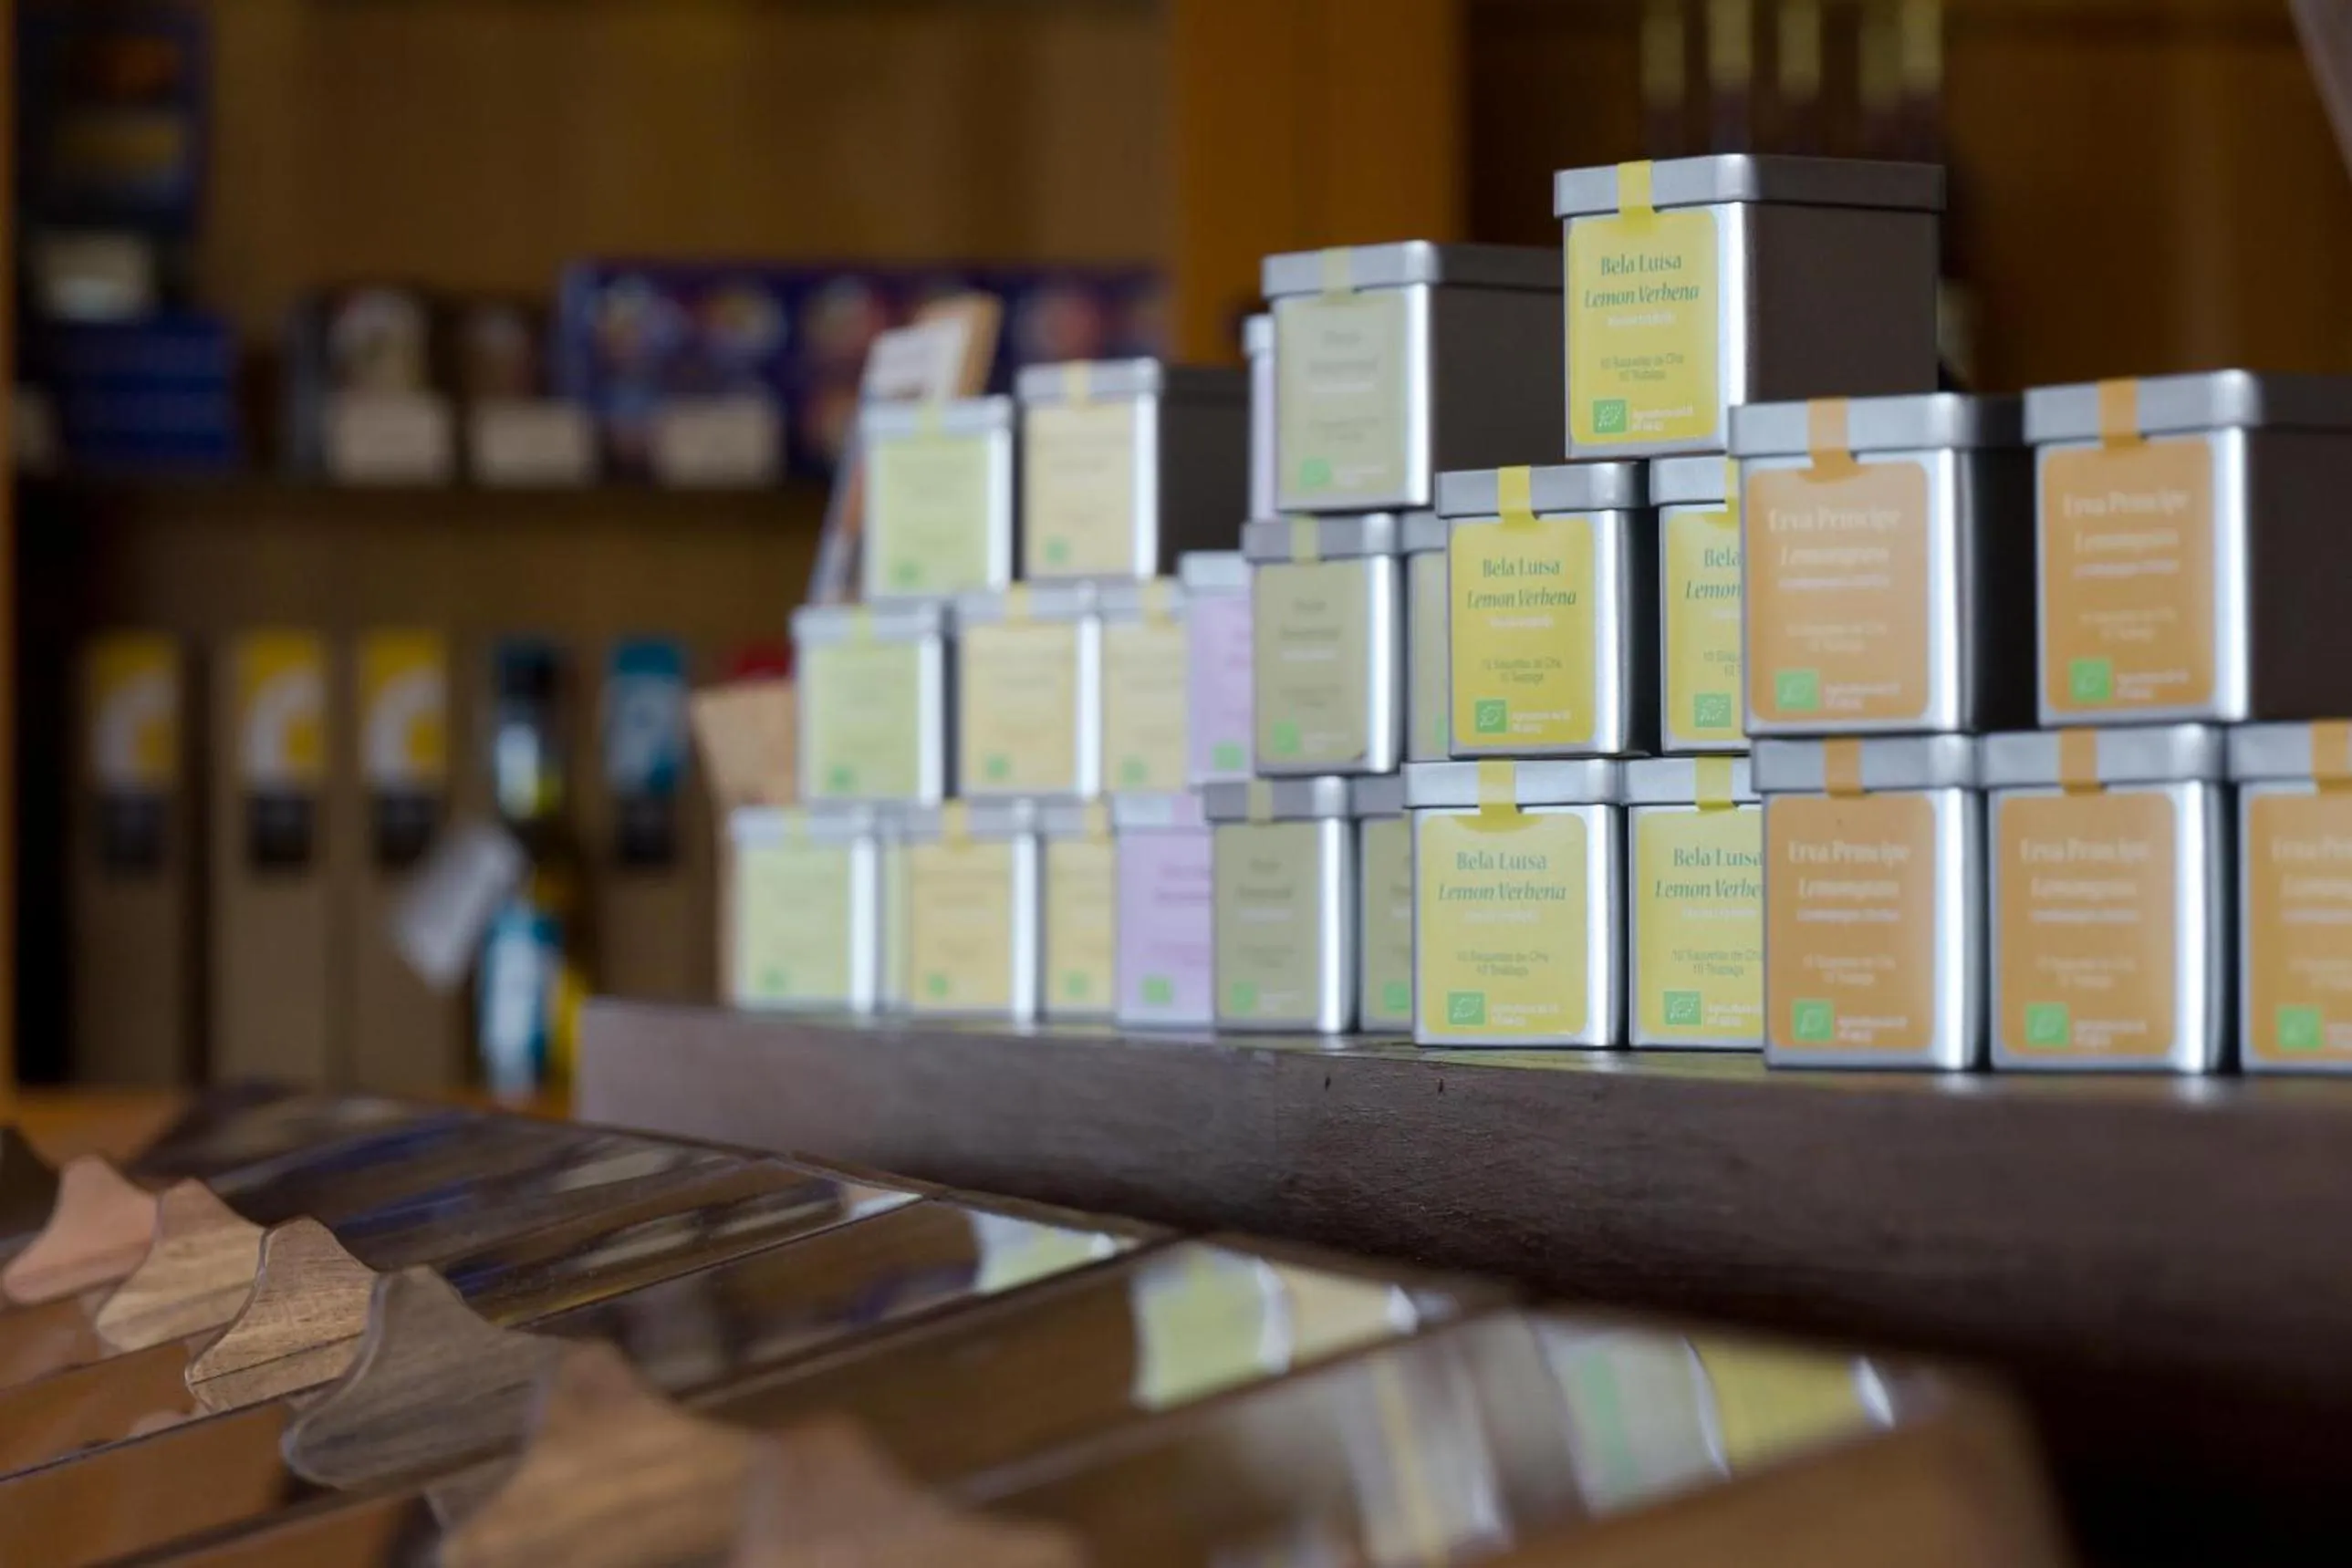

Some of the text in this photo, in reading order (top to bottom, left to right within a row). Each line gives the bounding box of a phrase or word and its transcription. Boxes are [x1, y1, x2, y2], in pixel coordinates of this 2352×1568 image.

[1600, 253, 1635, 276] Bela
[1584, 282, 1701, 308] Lemon Verbena
[1482, 557, 1515, 578] Bela
[1466, 587, 1577, 609] Lemon Verbena
[1685, 579, 1743, 600] Lemon
[1455, 850, 1494, 871] Bela
[1672, 846, 1711, 867] Bela
[1437, 880, 1567, 902] Lemon Verbena
[1654, 877, 1763, 899] Lemon Verbe
